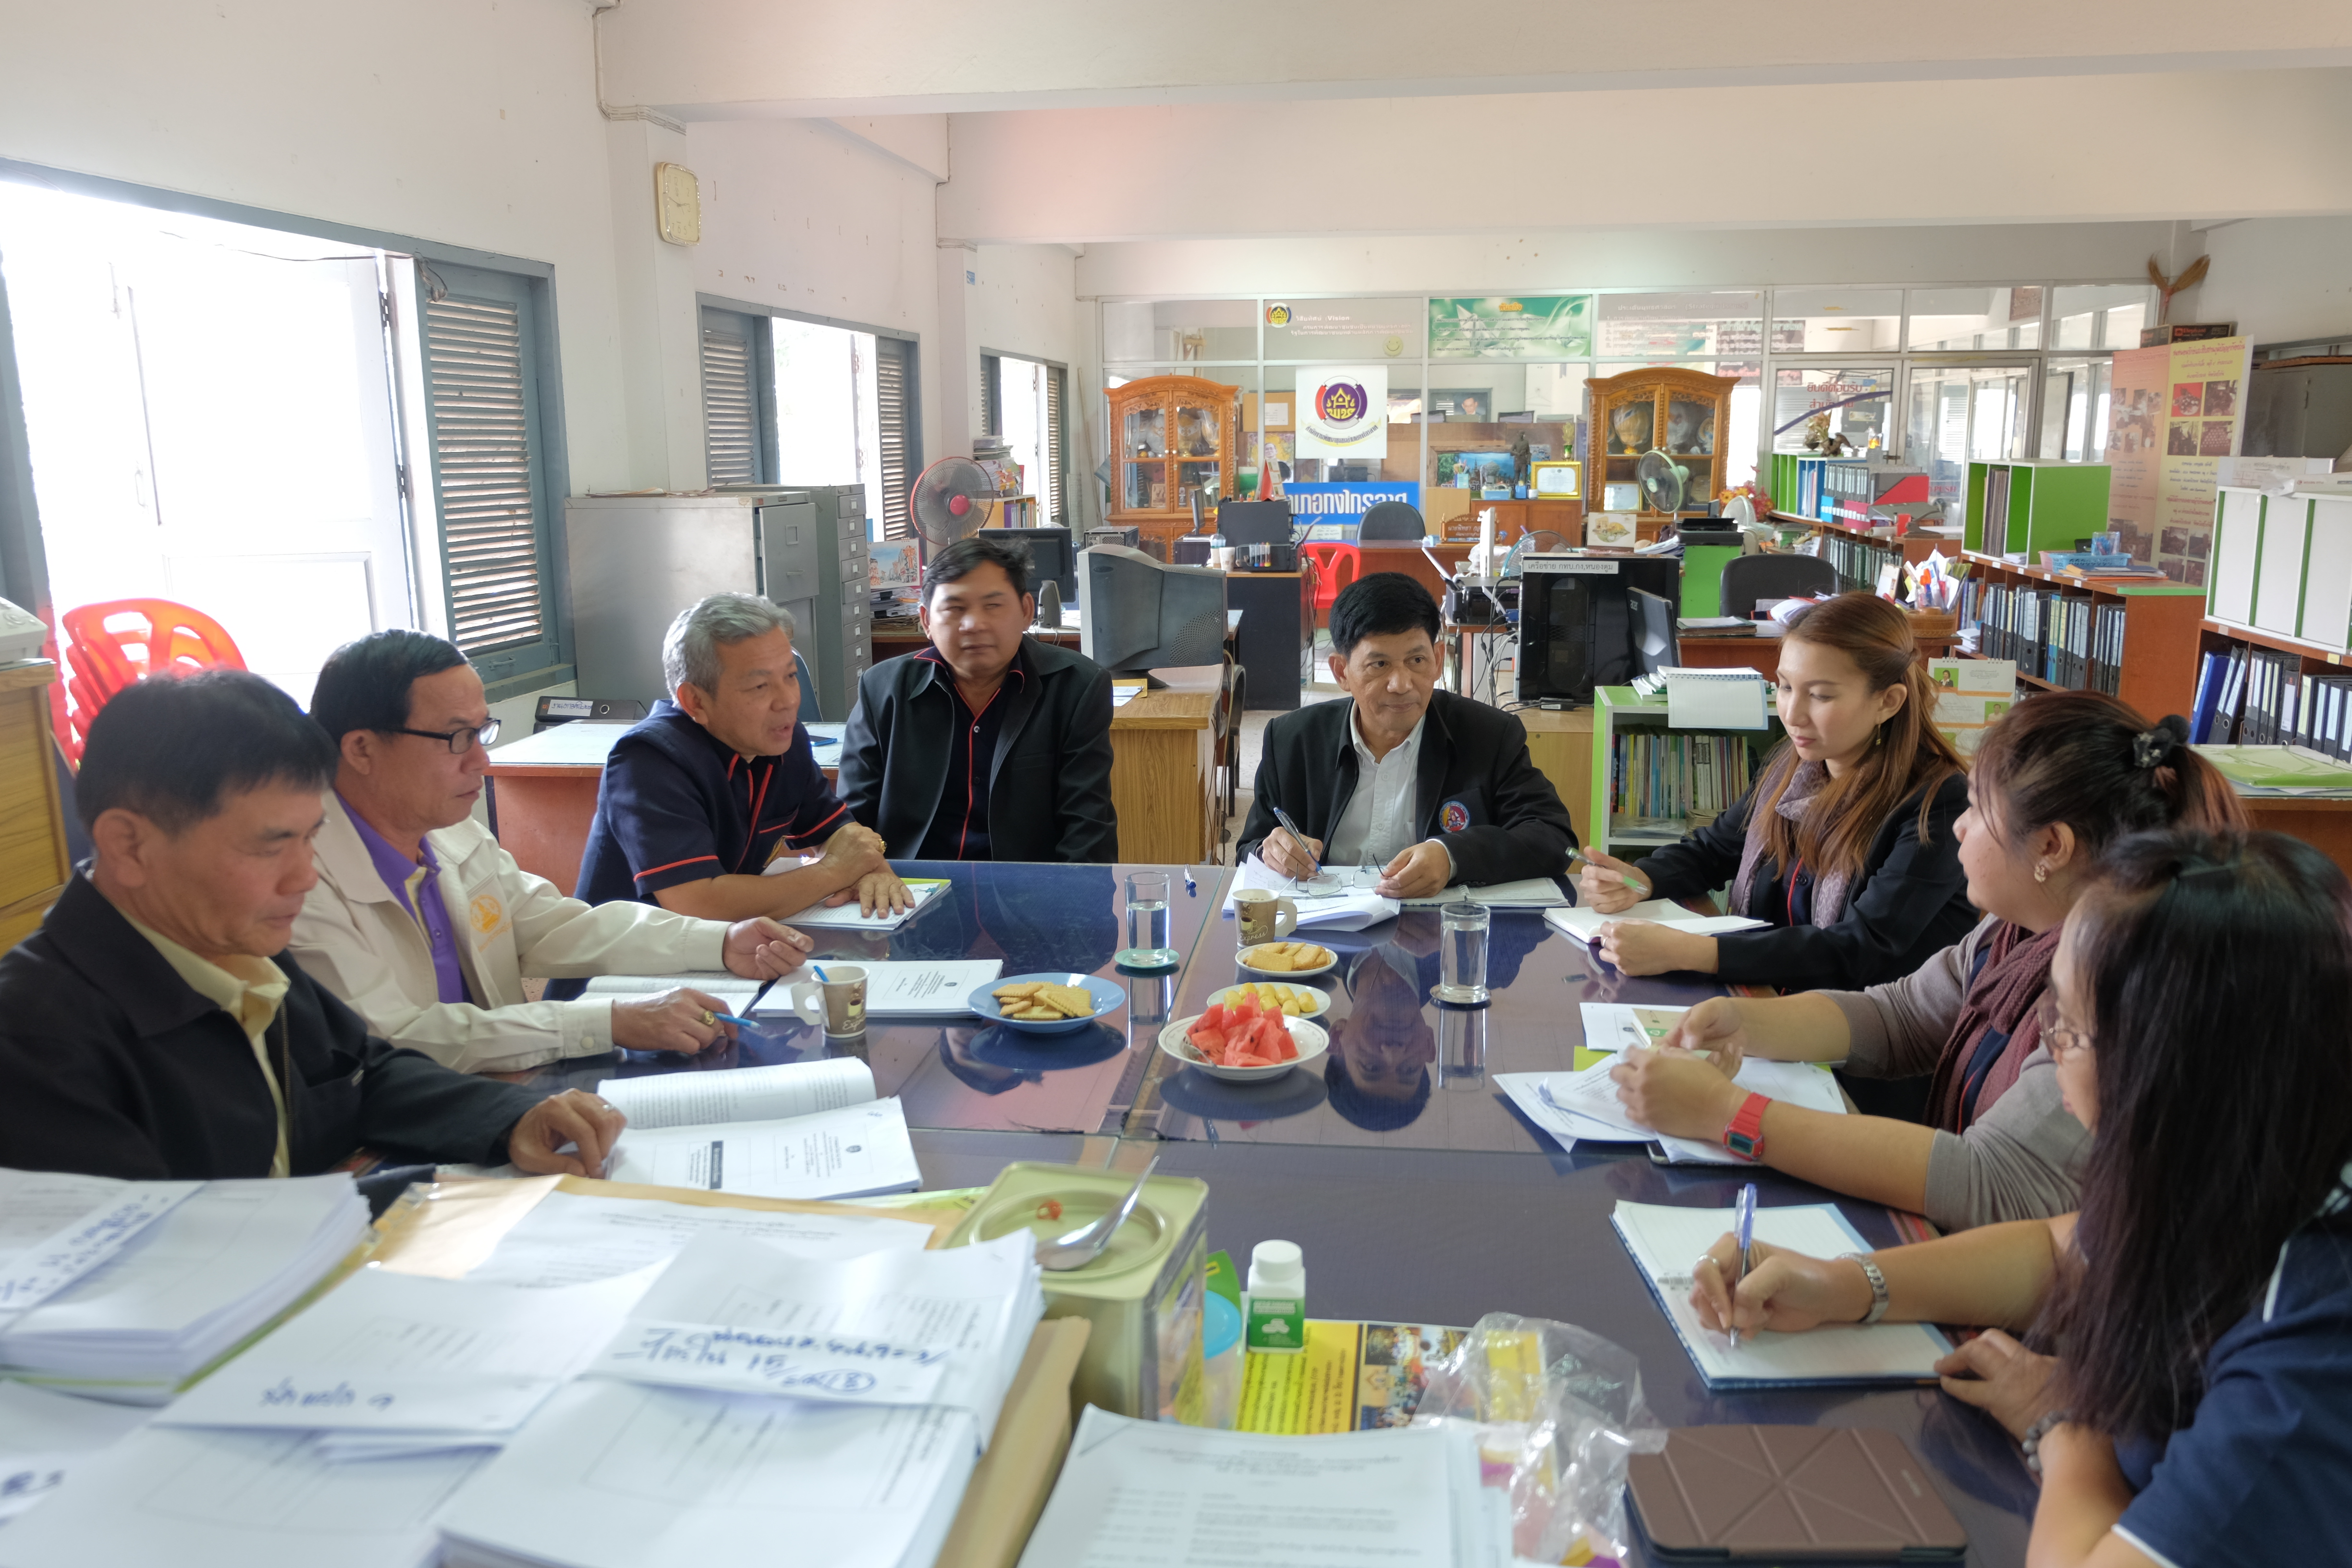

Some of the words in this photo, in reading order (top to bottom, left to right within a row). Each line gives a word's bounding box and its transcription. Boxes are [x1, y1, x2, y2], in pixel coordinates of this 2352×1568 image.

[1528, 561, 1556, 570] เครือข่าย
[1239, 932, 1267, 944] Express
